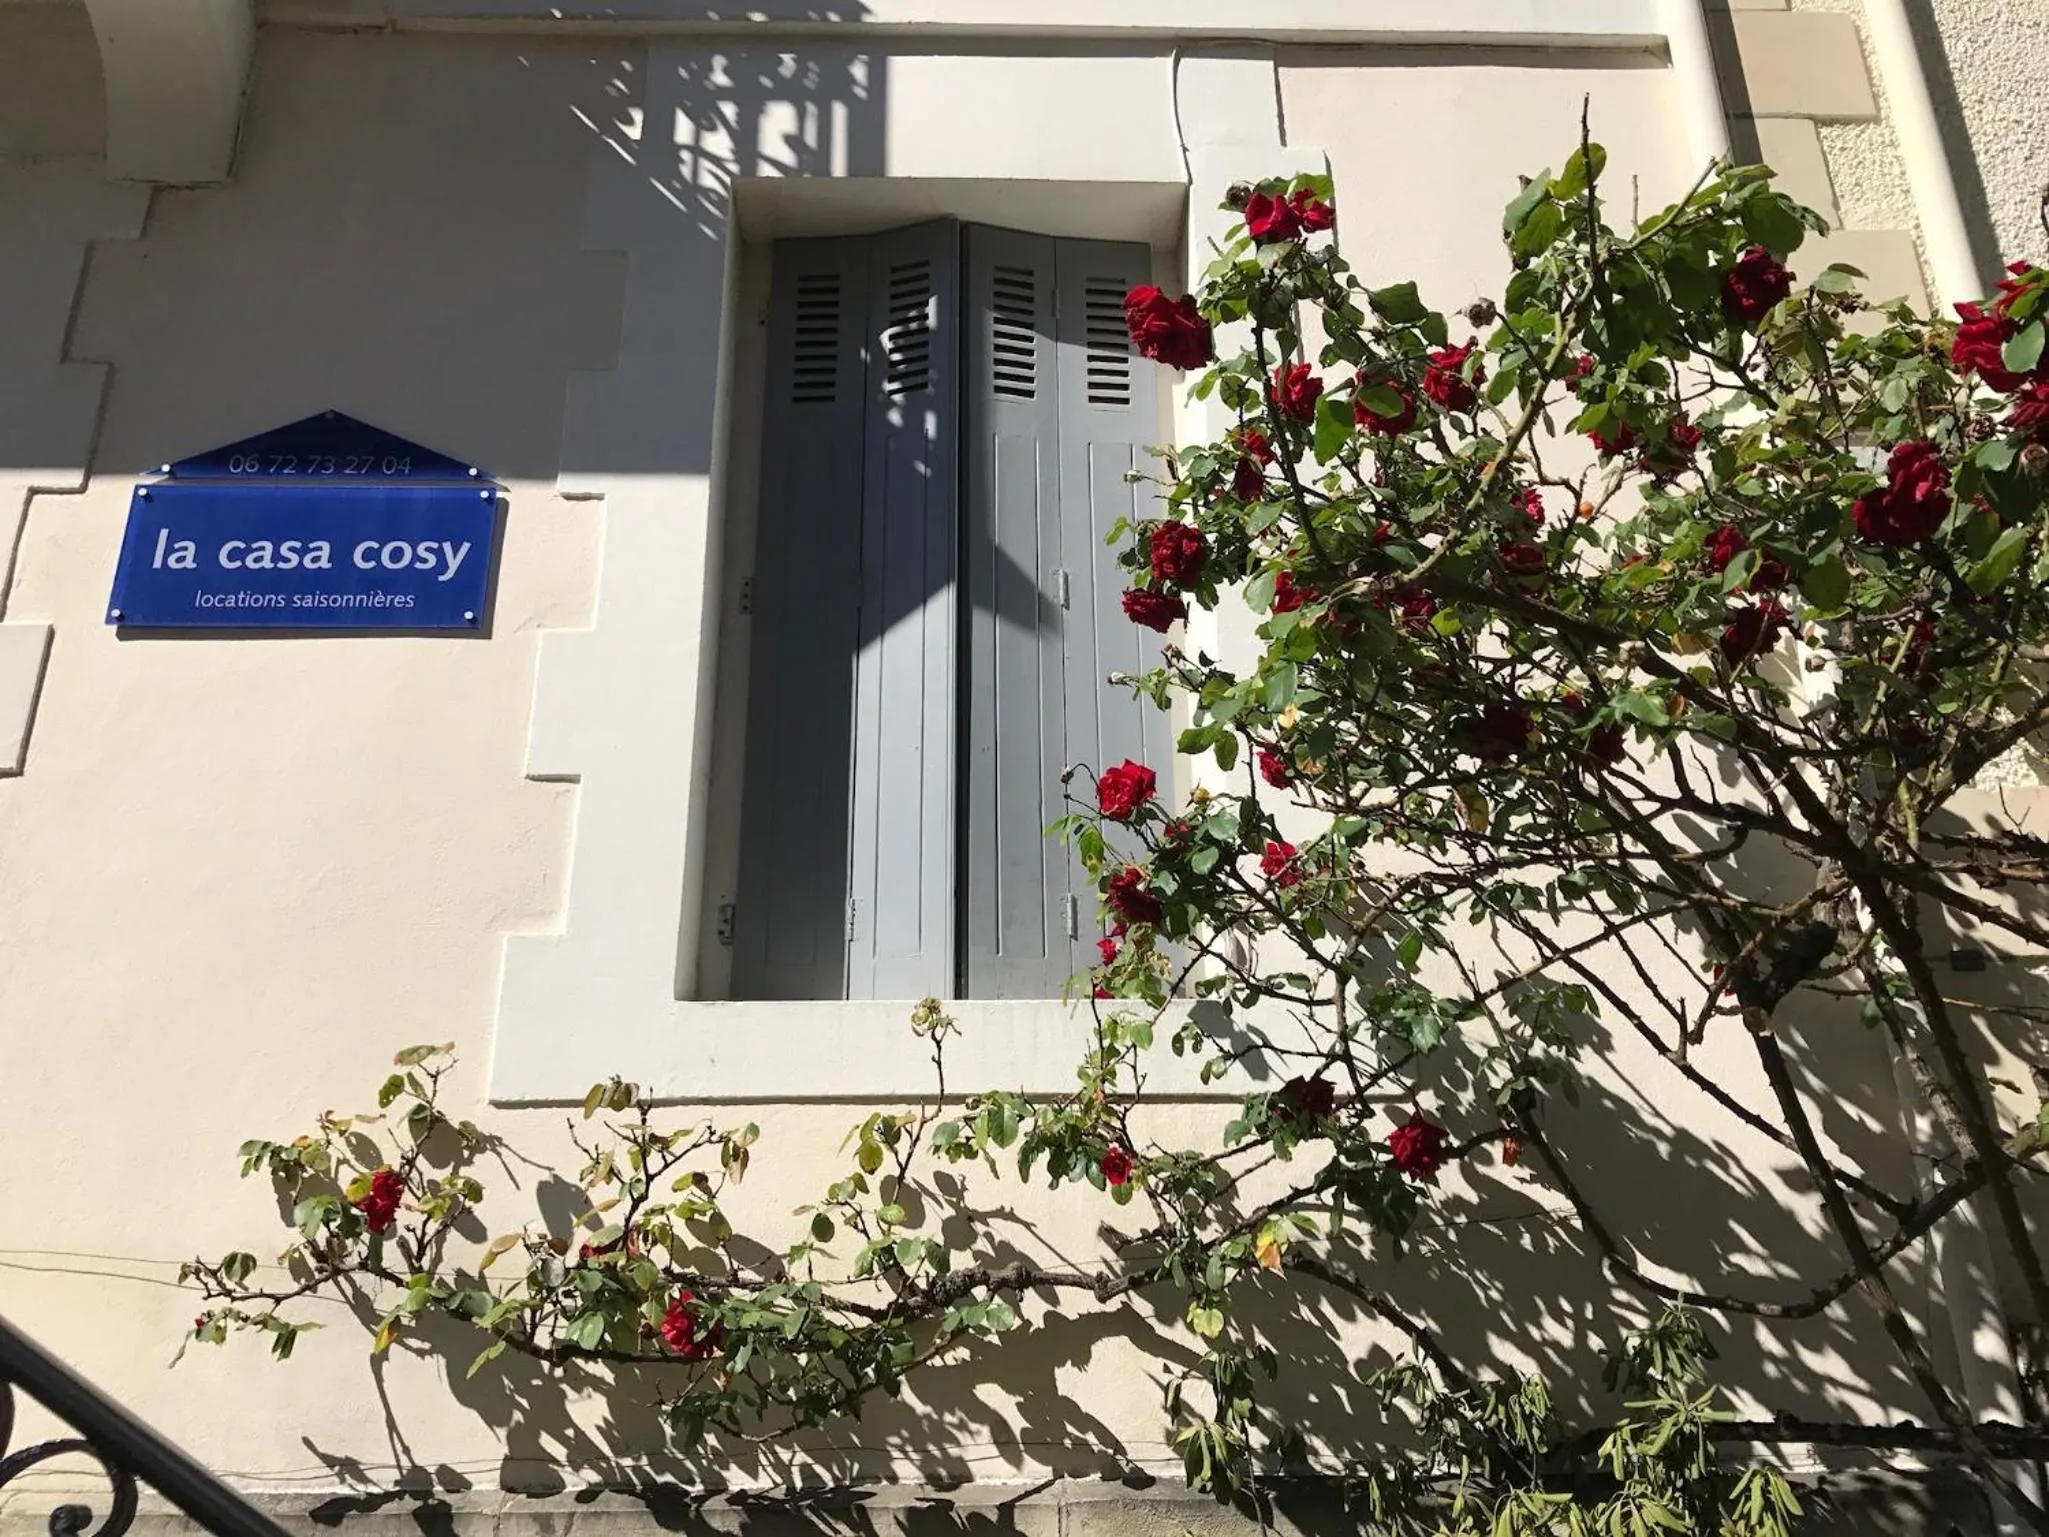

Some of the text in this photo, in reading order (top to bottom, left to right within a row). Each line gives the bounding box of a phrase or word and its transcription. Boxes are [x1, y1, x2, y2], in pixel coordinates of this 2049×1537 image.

[229, 455, 412, 474] 06 72 73 27 04
[152, 528, 472, 582] la casa cosy
[195, 590, 416, 608] locations saisonnières
